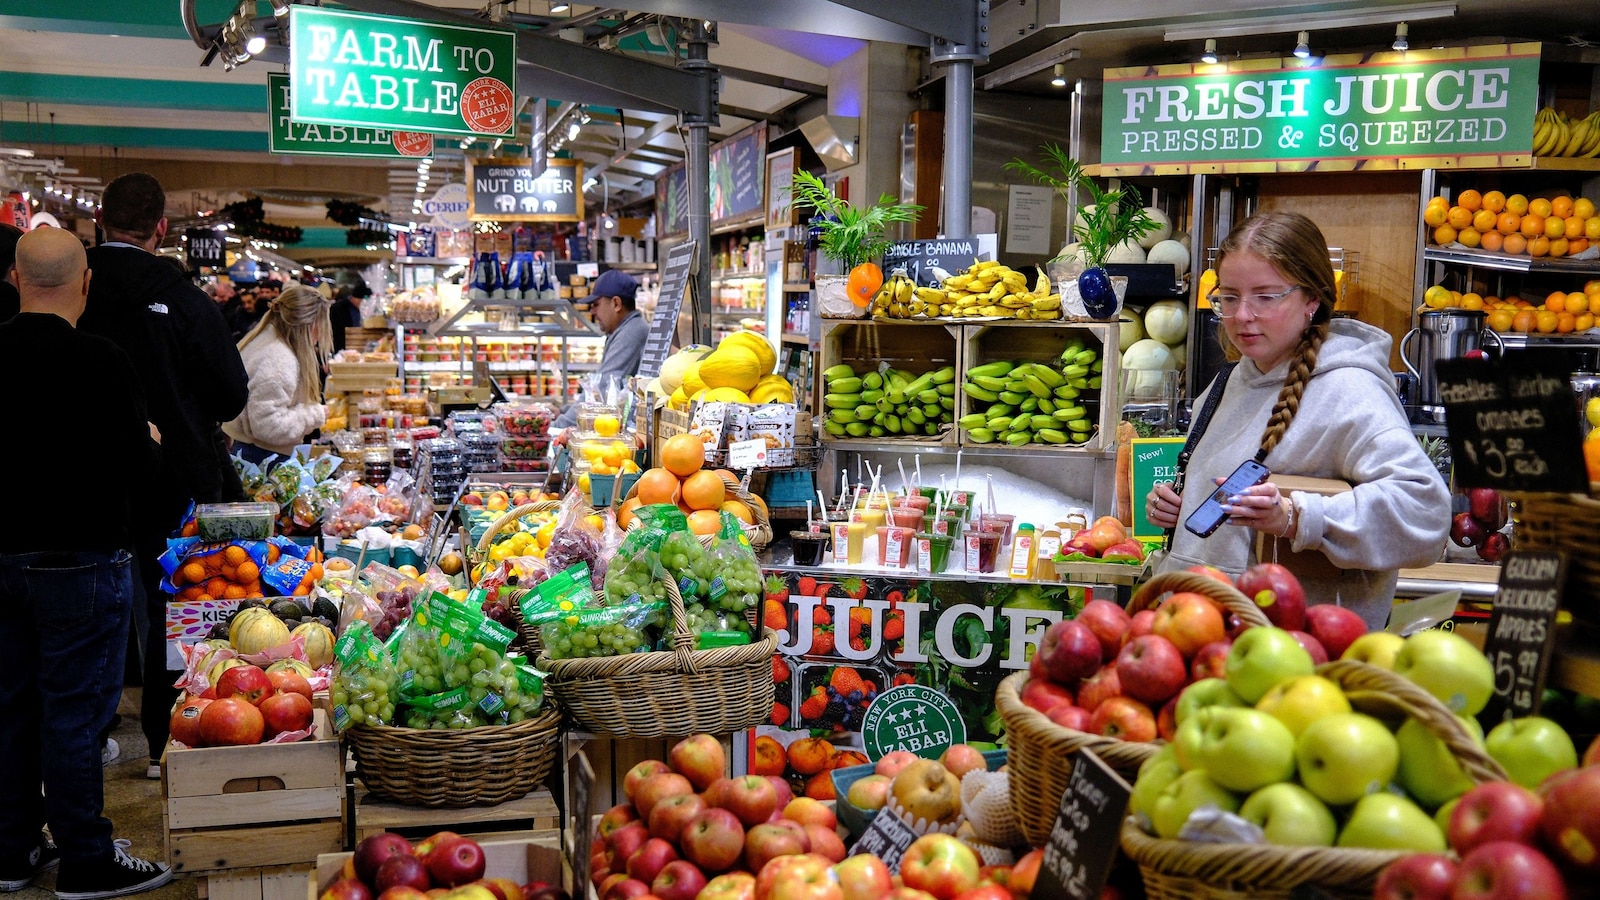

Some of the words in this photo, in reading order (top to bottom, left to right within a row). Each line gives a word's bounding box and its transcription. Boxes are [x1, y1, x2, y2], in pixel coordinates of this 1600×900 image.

[307, 25, 444, 74] FARM
[453, 46, 495, 74] TO
[305, 68, 458, 115] TABLE
[472, 79, 490, 89] YORK
[492, 80, 508, 92] CITY
[477, 97, 497, 109] ELI
[1121, 77, 1312, 124] FRESH
[1323, 67, 1511, 117] JUICE
[472, 103, 508, 120] ZABAR
[279, 117, 391, 145] TABLE
[1121, 126, 1263, 153] PRESSED
[1277, 124, 1304, 150] &
[1318, 117, 1507, 152] SQUEEZED
[401, 134, 429, 148] ZABAR
[488, 168, 516, 177] GRIND
[516, 168, 533, 178] YOU
[476, 179, 509, 193] NUT
[513, 179, 573, 194] BUTTER
[425, 201, 470, 215] CERIE
[191, 238, 221, 249] BIEN
[884, 243, 922, 257] SINGLE
[925, 241, 973, 256] BANANA
[190, 249, 221, 260] CUIT
[1138, 447, 1164, 463] New!
[1152, 466, 1177, 477] EL
[1494, 588, 1557, 612] DELICIOUS
[775, 594, 1064, 670] JUICE
[1494, 614, 1548, 643] APPLES
[866, 704, 883, 731] NEW
[882, 688, 917, 705] YORK
[921, 690, 950, 711] CITY
[894, 720, 928, 740] ELI
[883, 730, 950, 755] ZABAR
